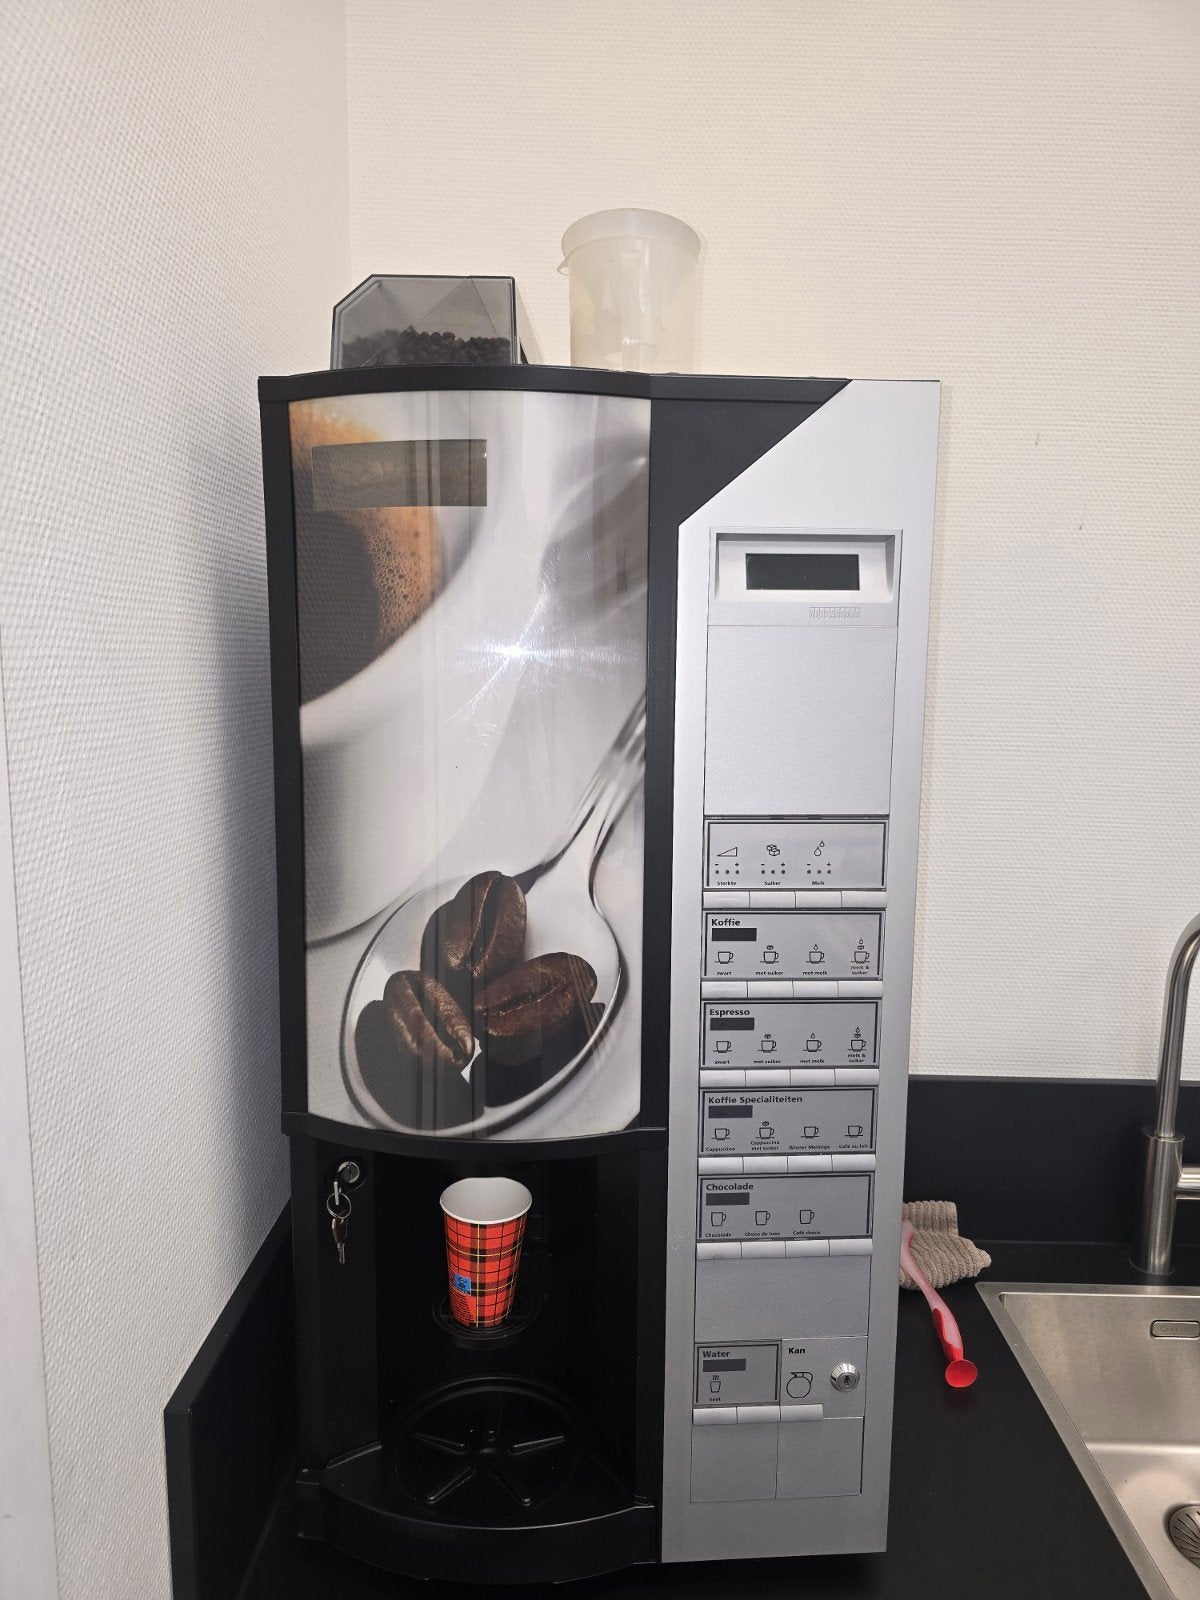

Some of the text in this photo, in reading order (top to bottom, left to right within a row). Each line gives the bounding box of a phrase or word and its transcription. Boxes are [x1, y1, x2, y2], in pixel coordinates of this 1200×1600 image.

[711, 918, 741, 927] Koffie
[709, 1008, 750, 1018] Espresso
[708, 1096, 803, 1106] Koffie Specialiteiten
[705, 1183, 754, 1191] Chocolade
[702, 1350, 731, 1358] Water
[788, 1347, 806, 1355] Kan
